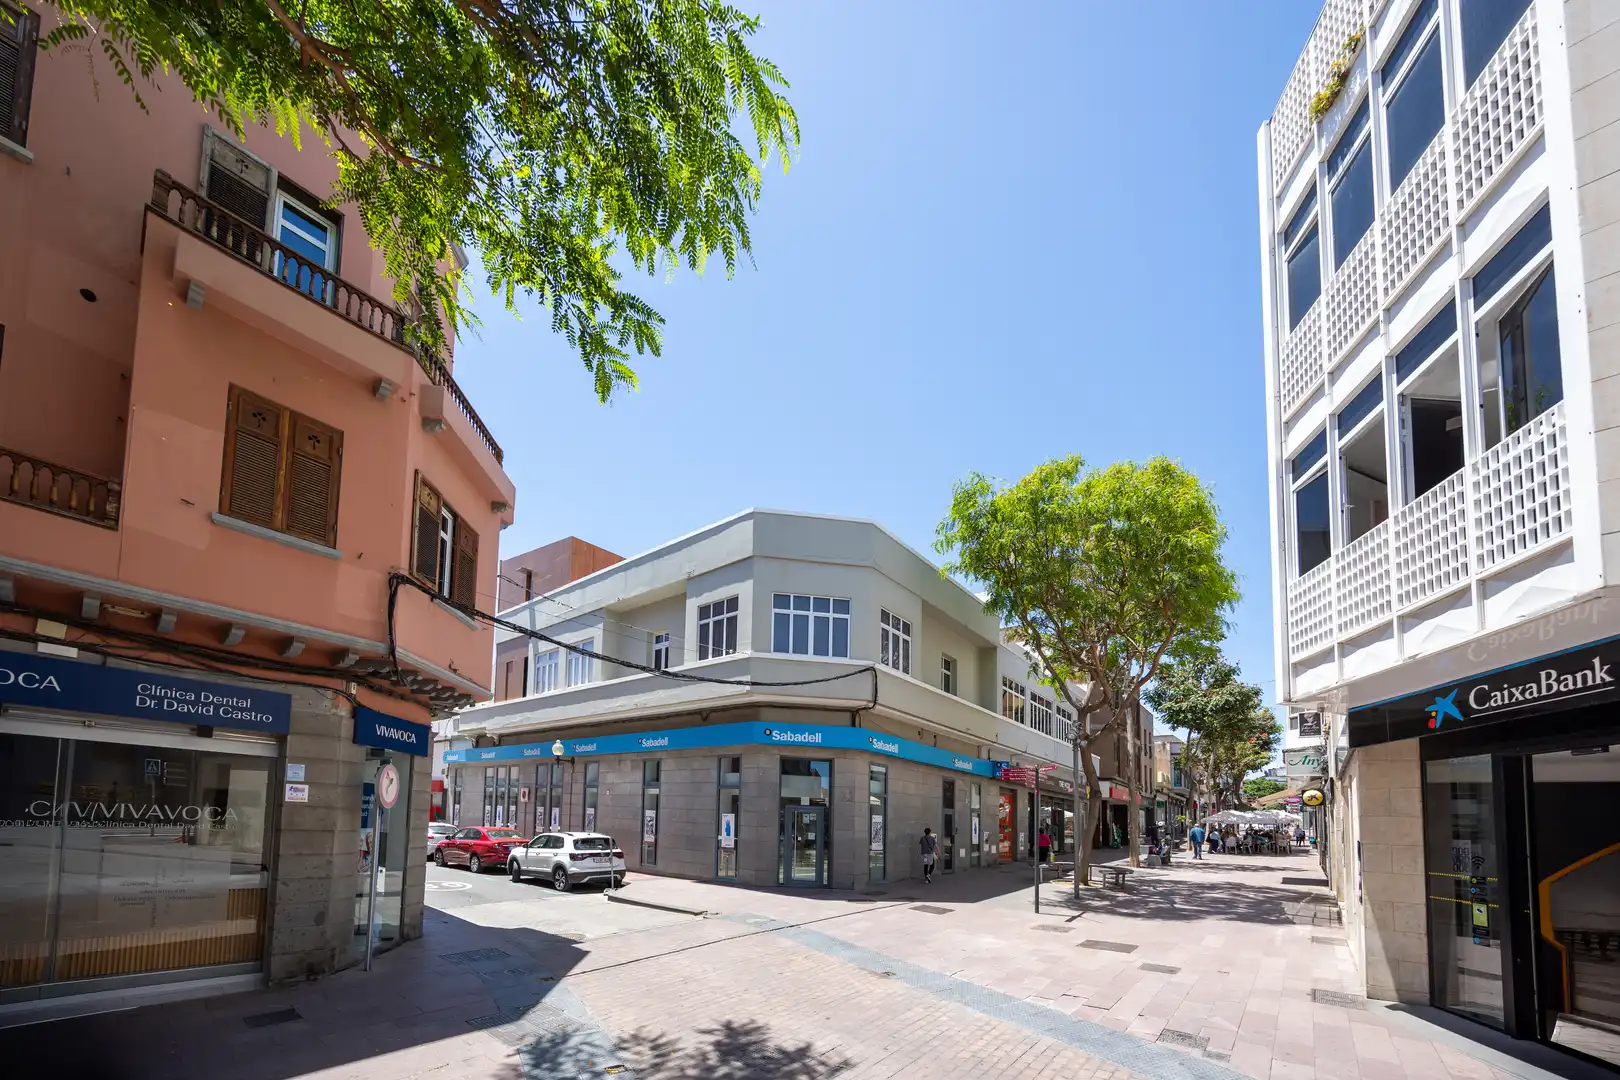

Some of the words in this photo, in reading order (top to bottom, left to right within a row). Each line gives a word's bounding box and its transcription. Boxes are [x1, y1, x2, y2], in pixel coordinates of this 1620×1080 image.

[1468, 656, 1615, 710] CaixaBank
[137, 683, 195, 701] Clínica
[201, 692, 251, 708] Dental
[136, 695, 158, 709] Dr.
[163, 699, 213, 716] David
[219, 707, 273, 723] Castro
[375, 724, 417, 744] VIVAVOCA
[772, 730, 822, 743] Sabadell
[575, 743, 597, 752] Sabadell
[642, 737, 669, 747] Sabadell
[872, 738, 899, 754] Sabadell
[523, 747, 540, 756] Sabadell
[954, 759, 973, 770] Sabadell
[98, 801, 239, 822] VIVAVOCA
[138, 820, 173, 829] Dental
